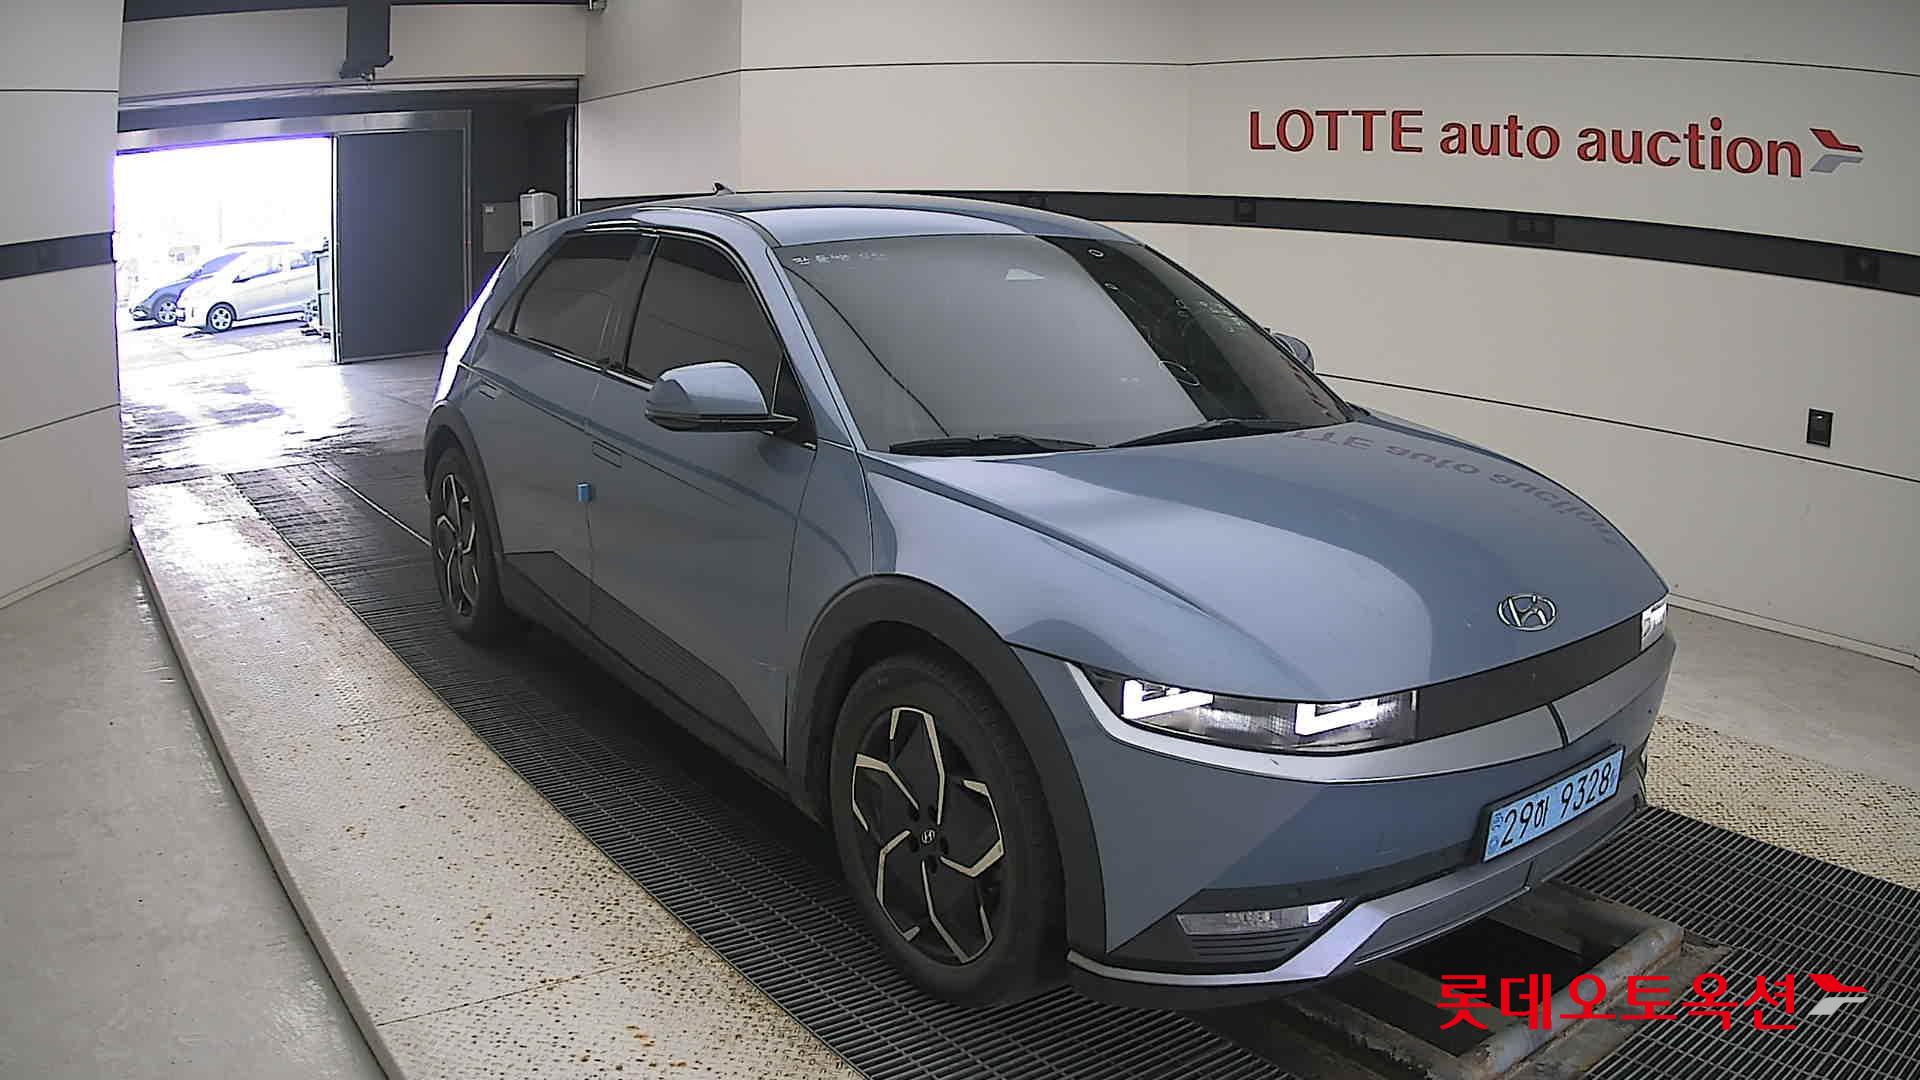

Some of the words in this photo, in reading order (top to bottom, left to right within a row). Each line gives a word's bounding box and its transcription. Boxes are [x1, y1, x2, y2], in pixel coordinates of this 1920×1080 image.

[1248, 110, 1425, 154] LOTTE
[1440, 114, 1561, 160] auto
[1577, 116, 1804, 178] auction
[1560, 762, 1612, 819] 9328
